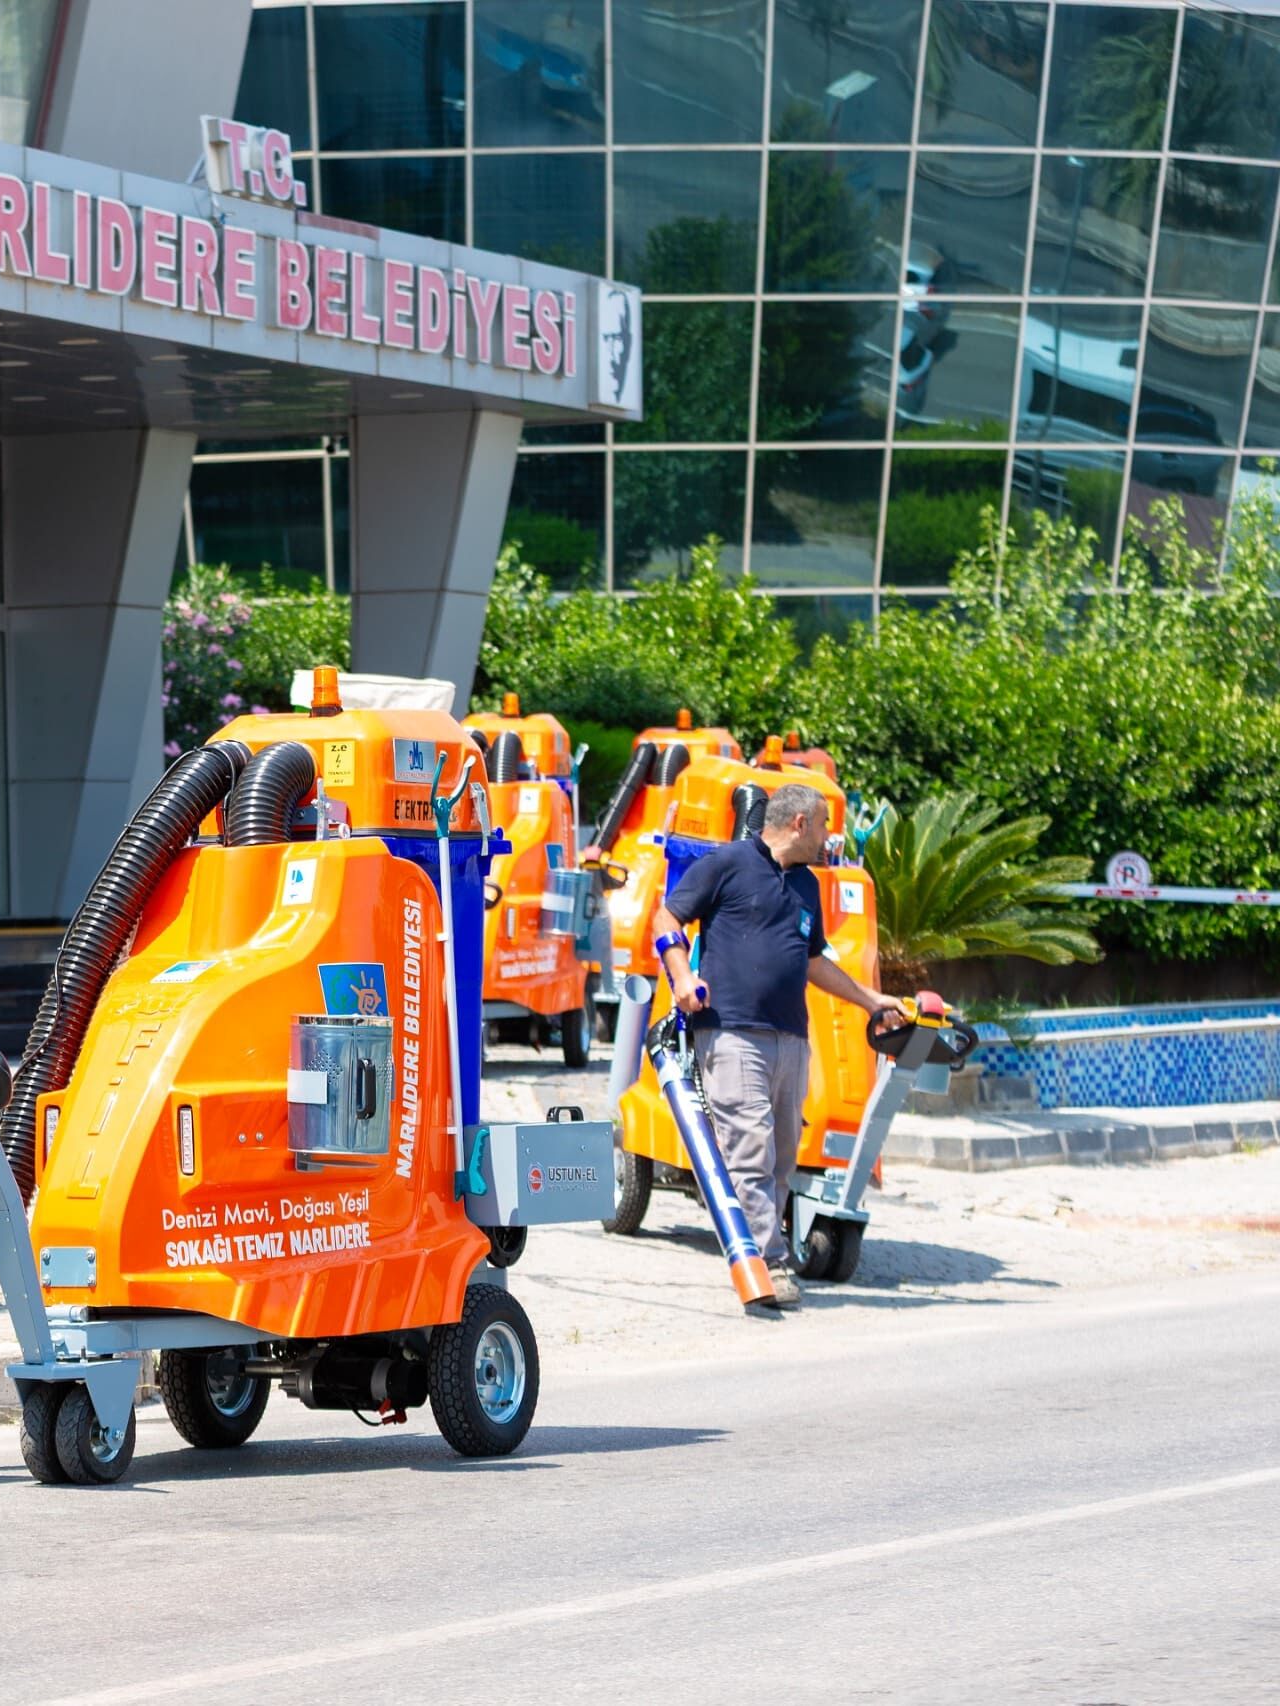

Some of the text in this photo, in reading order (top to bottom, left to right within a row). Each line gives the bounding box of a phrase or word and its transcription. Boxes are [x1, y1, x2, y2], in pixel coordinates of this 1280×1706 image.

[220, 119, 307, 206] T.C.
[277, 238, 576, 376] BELEDİYESİ
[396, 898, 421, 1179] NARLIDERE BELEDİYESİ
[162, 1188, 369, 1230] Denizi Mavi, Doğası Yeşil
[166, 1222, 371, 1267] SOKAĞI TEMİZ NARLIDERE
